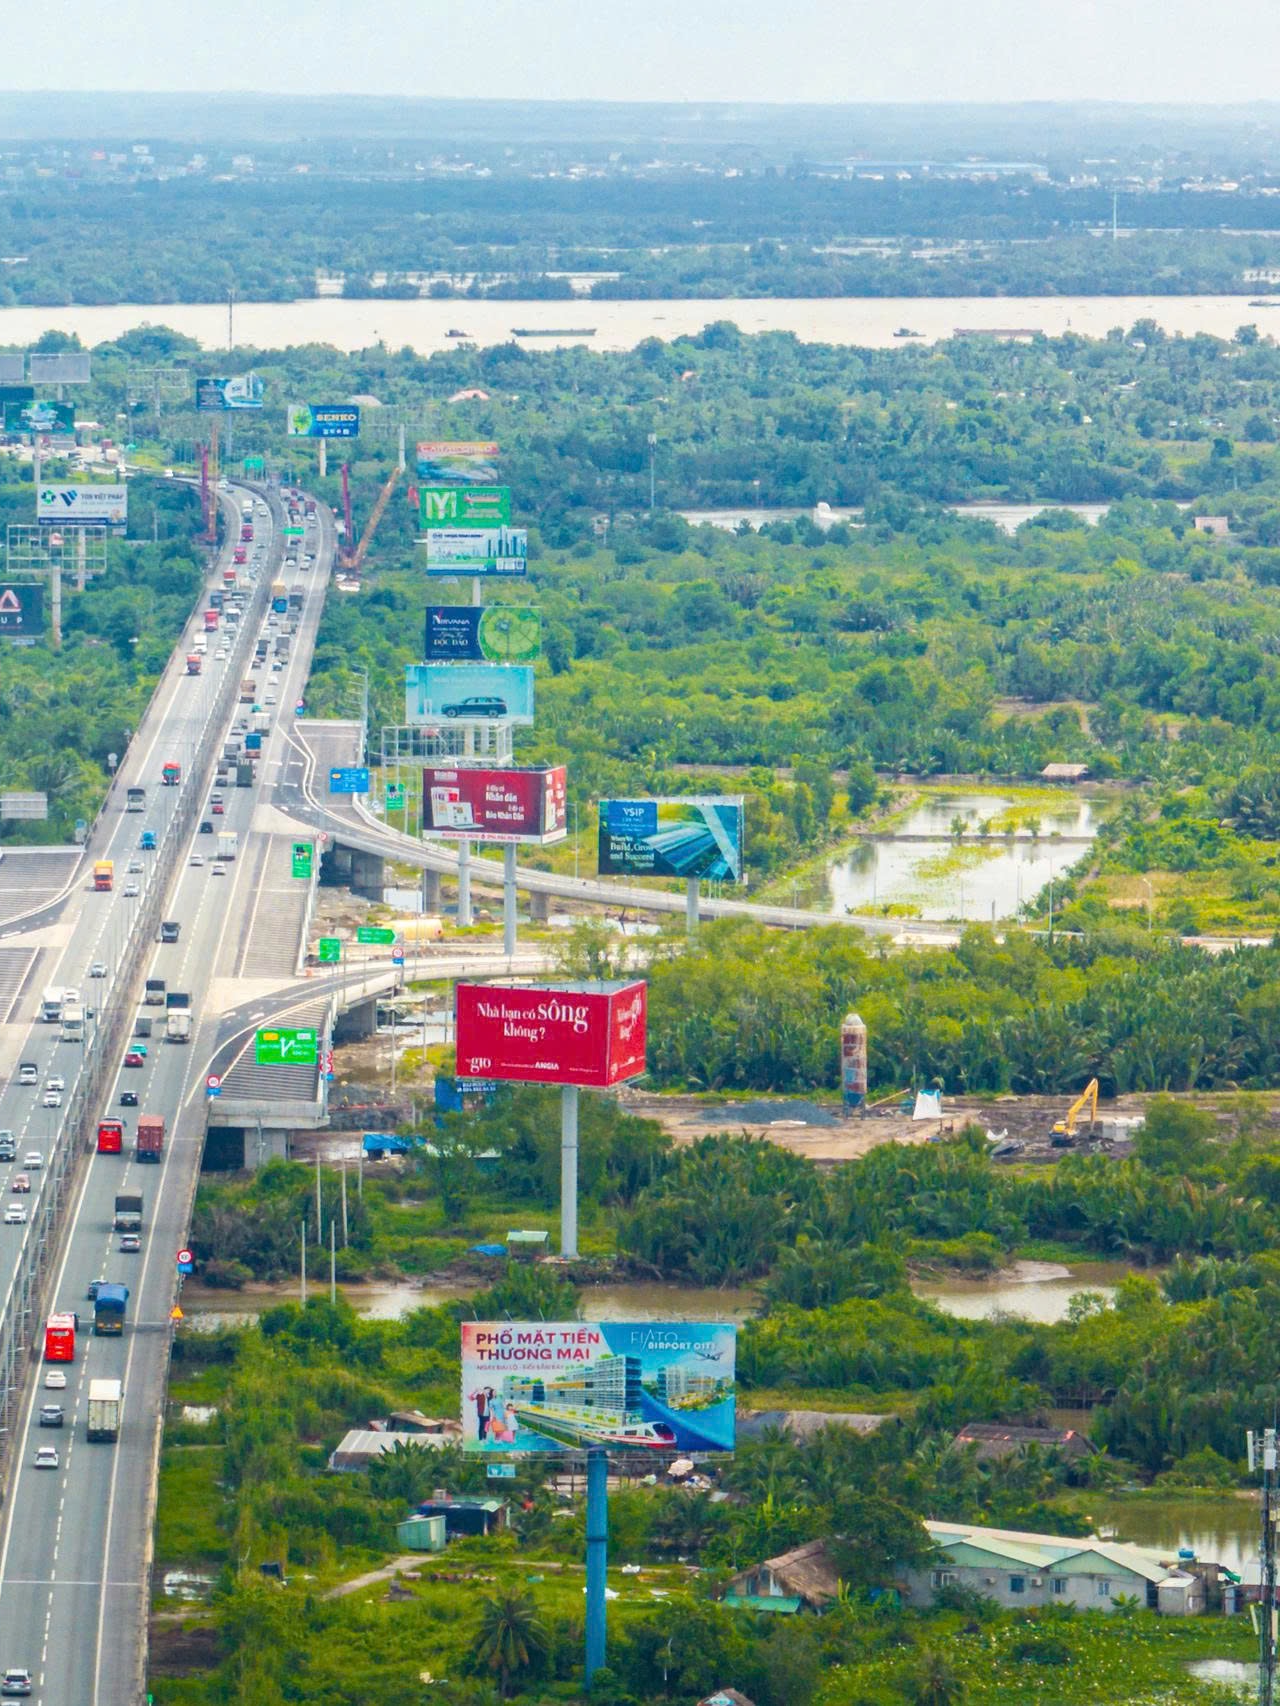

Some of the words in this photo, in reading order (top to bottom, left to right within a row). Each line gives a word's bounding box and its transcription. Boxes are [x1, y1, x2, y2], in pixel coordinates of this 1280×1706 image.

[623, 807, 645, 817] VSIP
[477, 1002, 500, 1018] Nhà
[500, 1003, 522, 1022] bạn
[522, 1007, 536, 1021] có
[537, 1000, 590, 1034] sông
[535, 1061, 560, 1071] ANGIA
[476, 1328, 513, 1345] PHỐ
[517, 1330, 557, 1347] MẶT
[560, 1327, 600, 1345] TIỀN
[476, 1347, 552, 1361] THƯƠNG
[556, 1348, 590, 1362] MẠI
